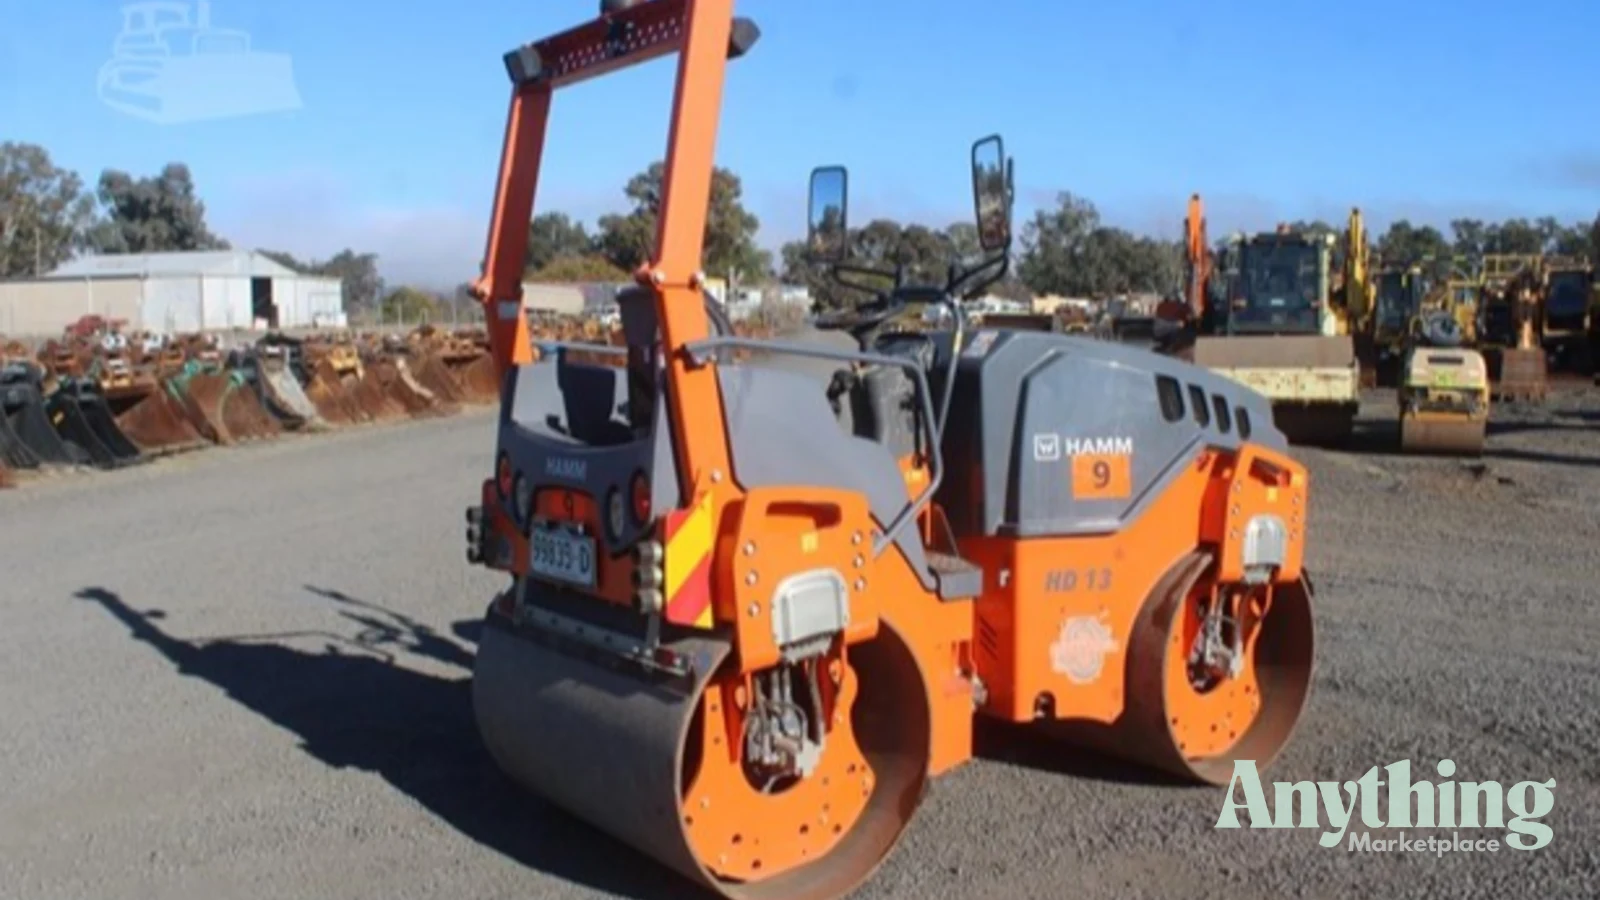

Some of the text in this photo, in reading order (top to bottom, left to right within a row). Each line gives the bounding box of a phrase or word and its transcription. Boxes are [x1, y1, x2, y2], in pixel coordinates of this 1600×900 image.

[1065, 437, 1133, 455] HAMM
[544, 456, 588, 480] HAMM
[1093, 460, 1111, 489] 9
[1045, 566, 1112, 592] HD 13
